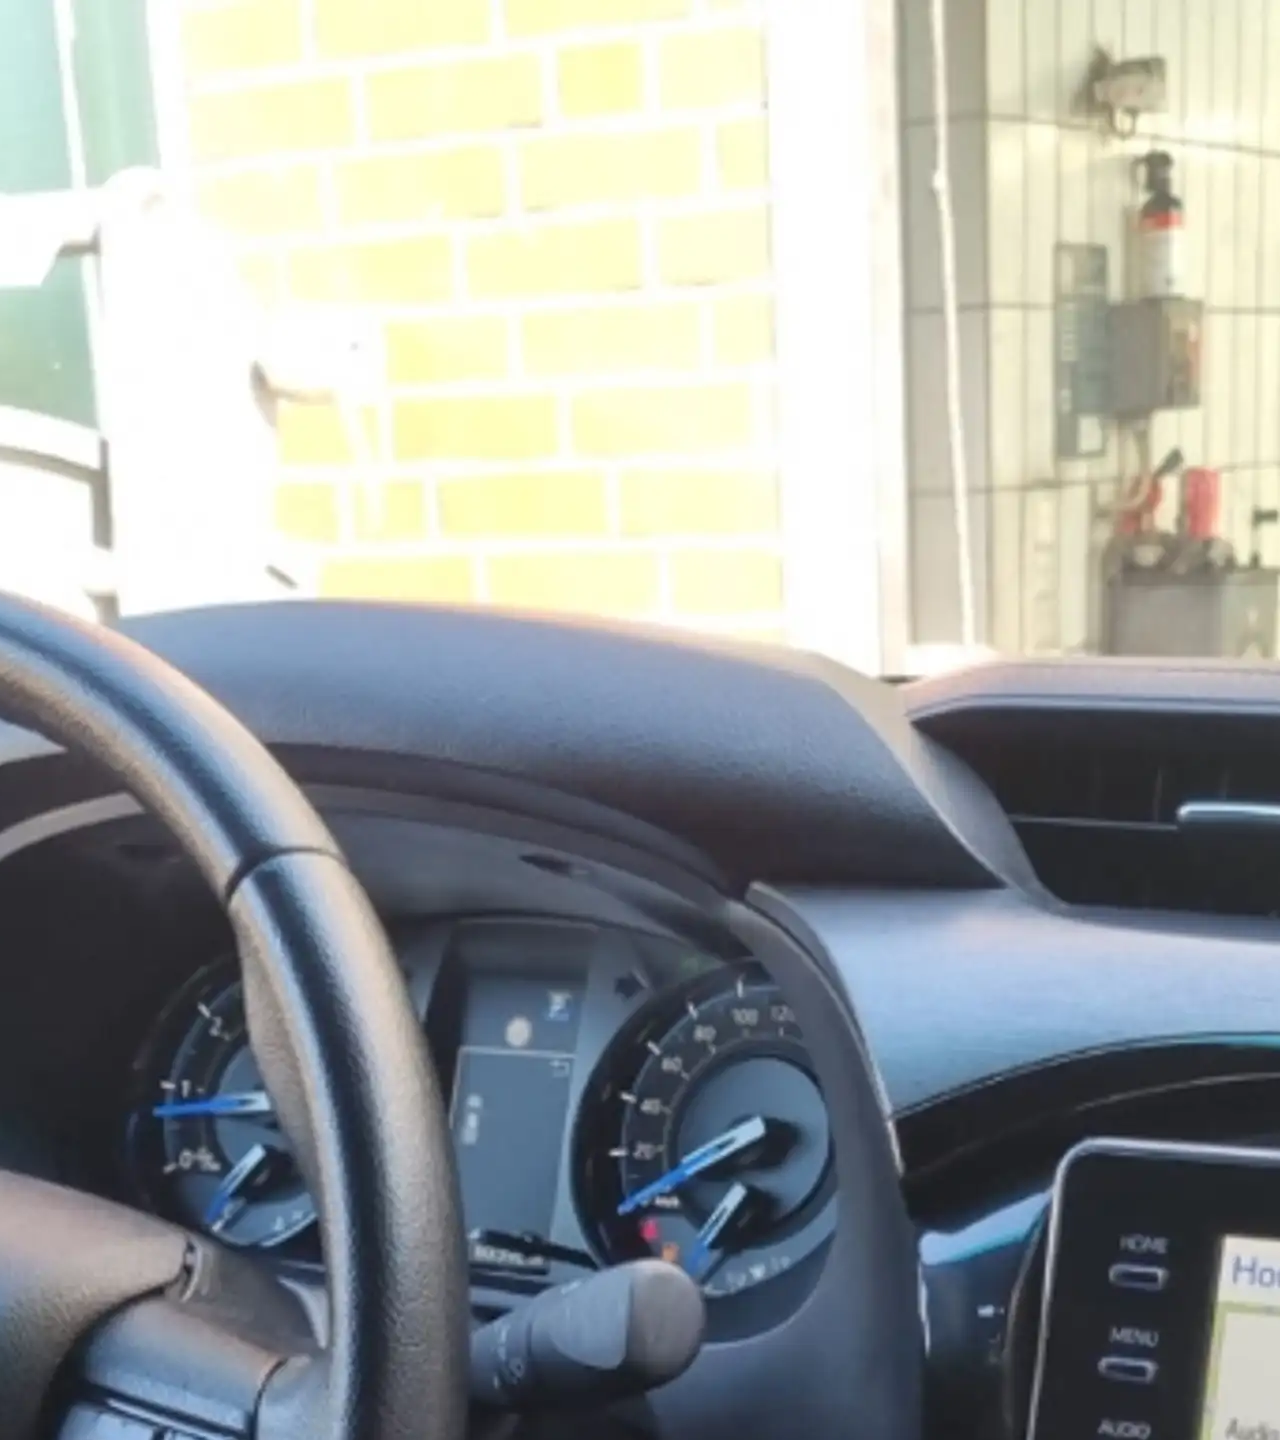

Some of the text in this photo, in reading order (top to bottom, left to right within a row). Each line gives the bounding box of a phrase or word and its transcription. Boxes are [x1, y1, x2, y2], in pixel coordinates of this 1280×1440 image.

[1120, 1234, 1168, 1255] HOME
[1110, 1327, 1159, 1348] MENU
[1098, 1418, 1151, 1440] AUDIO
